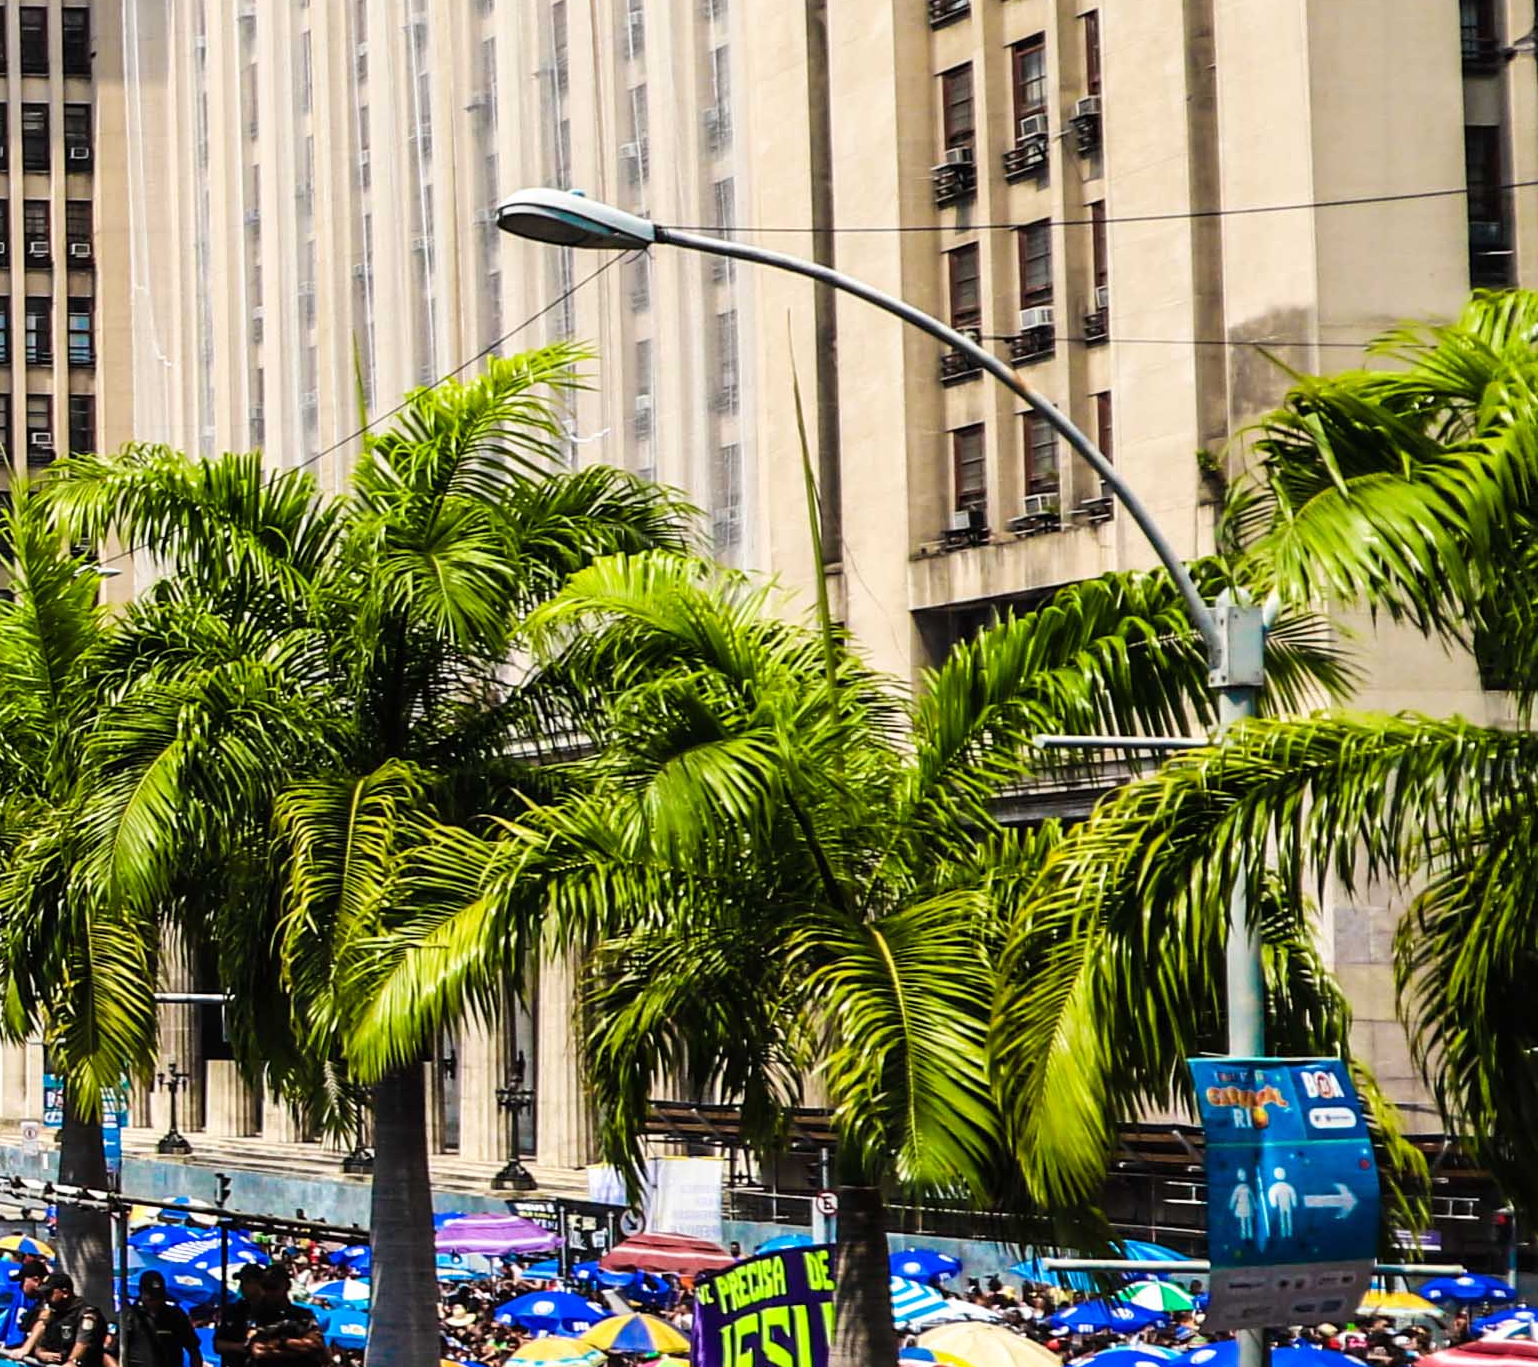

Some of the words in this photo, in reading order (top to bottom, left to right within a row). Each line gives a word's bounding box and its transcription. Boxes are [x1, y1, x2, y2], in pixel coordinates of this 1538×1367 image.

[1300, 1071, 1344, 1099] BOA
[715, 1257, 788, 1315] PRECISA
[803, 1250, 837, 1292] DE
